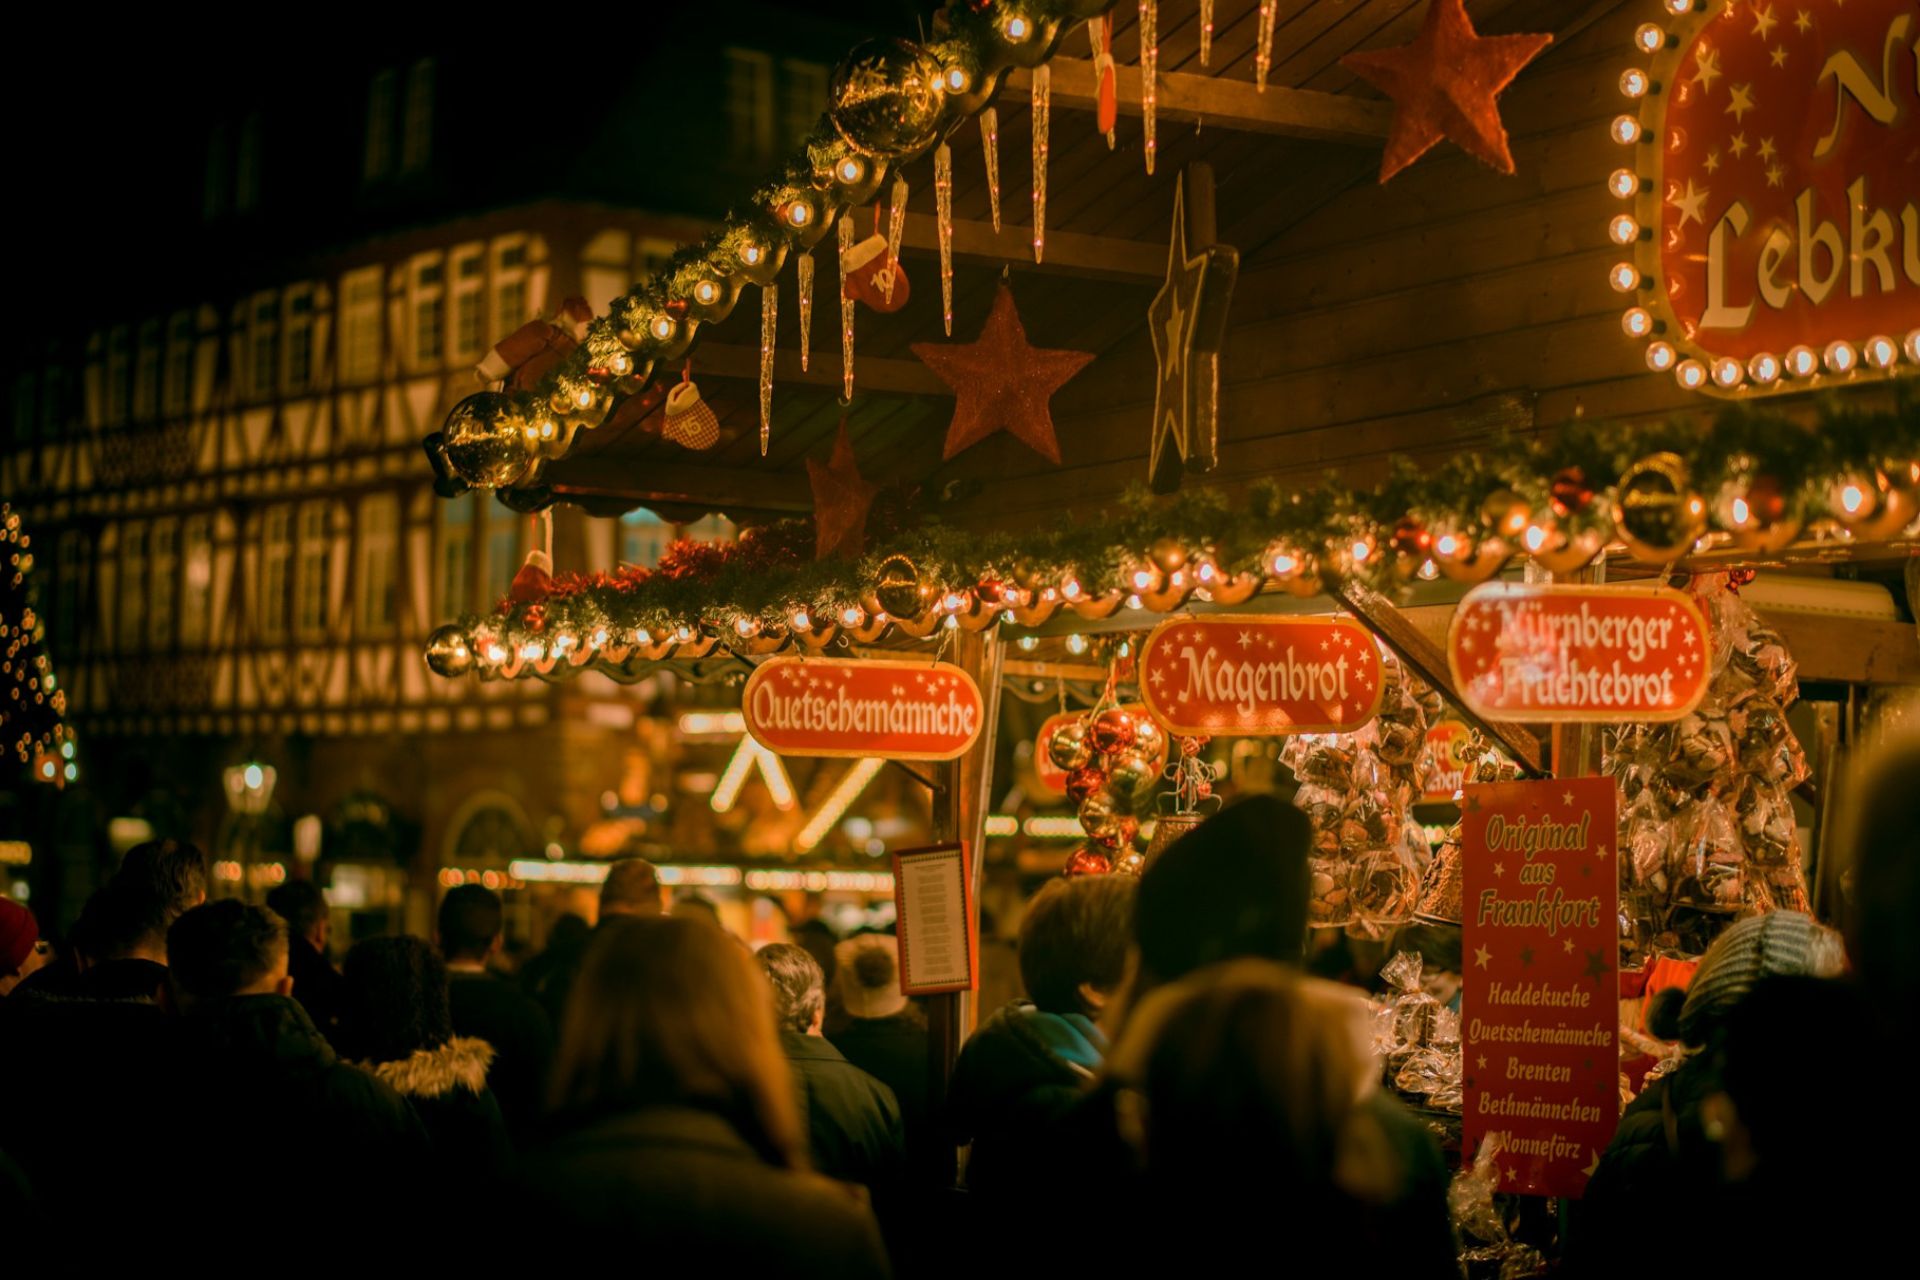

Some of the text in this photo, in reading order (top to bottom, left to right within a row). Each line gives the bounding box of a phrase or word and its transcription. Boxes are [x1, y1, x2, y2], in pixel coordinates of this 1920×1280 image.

[1813, 13, 1920, 158] N
[1494, 600, 1673, 662] Nürnberger
[1177, 645, 1349, 718] Magenbrot
[1494, 653, 1674, 706] Früchtebrot
[752, 680, 975, 736] Quetschemännche
[1486, 809, 1591, 861] Original
[1519, 863, 1556, 885] aus
[1477, 887, 1601, 938] Frankfort
[1488, 982, 1591, 1009] Haddekuche
[1468, 1018, 1613, 1047] Quetschemännche
[1505, 1056, 1571, 1083] Brenten
[1478, 1091, 1601, 1123] Bethmännchen
[1498, 1130, 1581, 1162] Nonneförz
